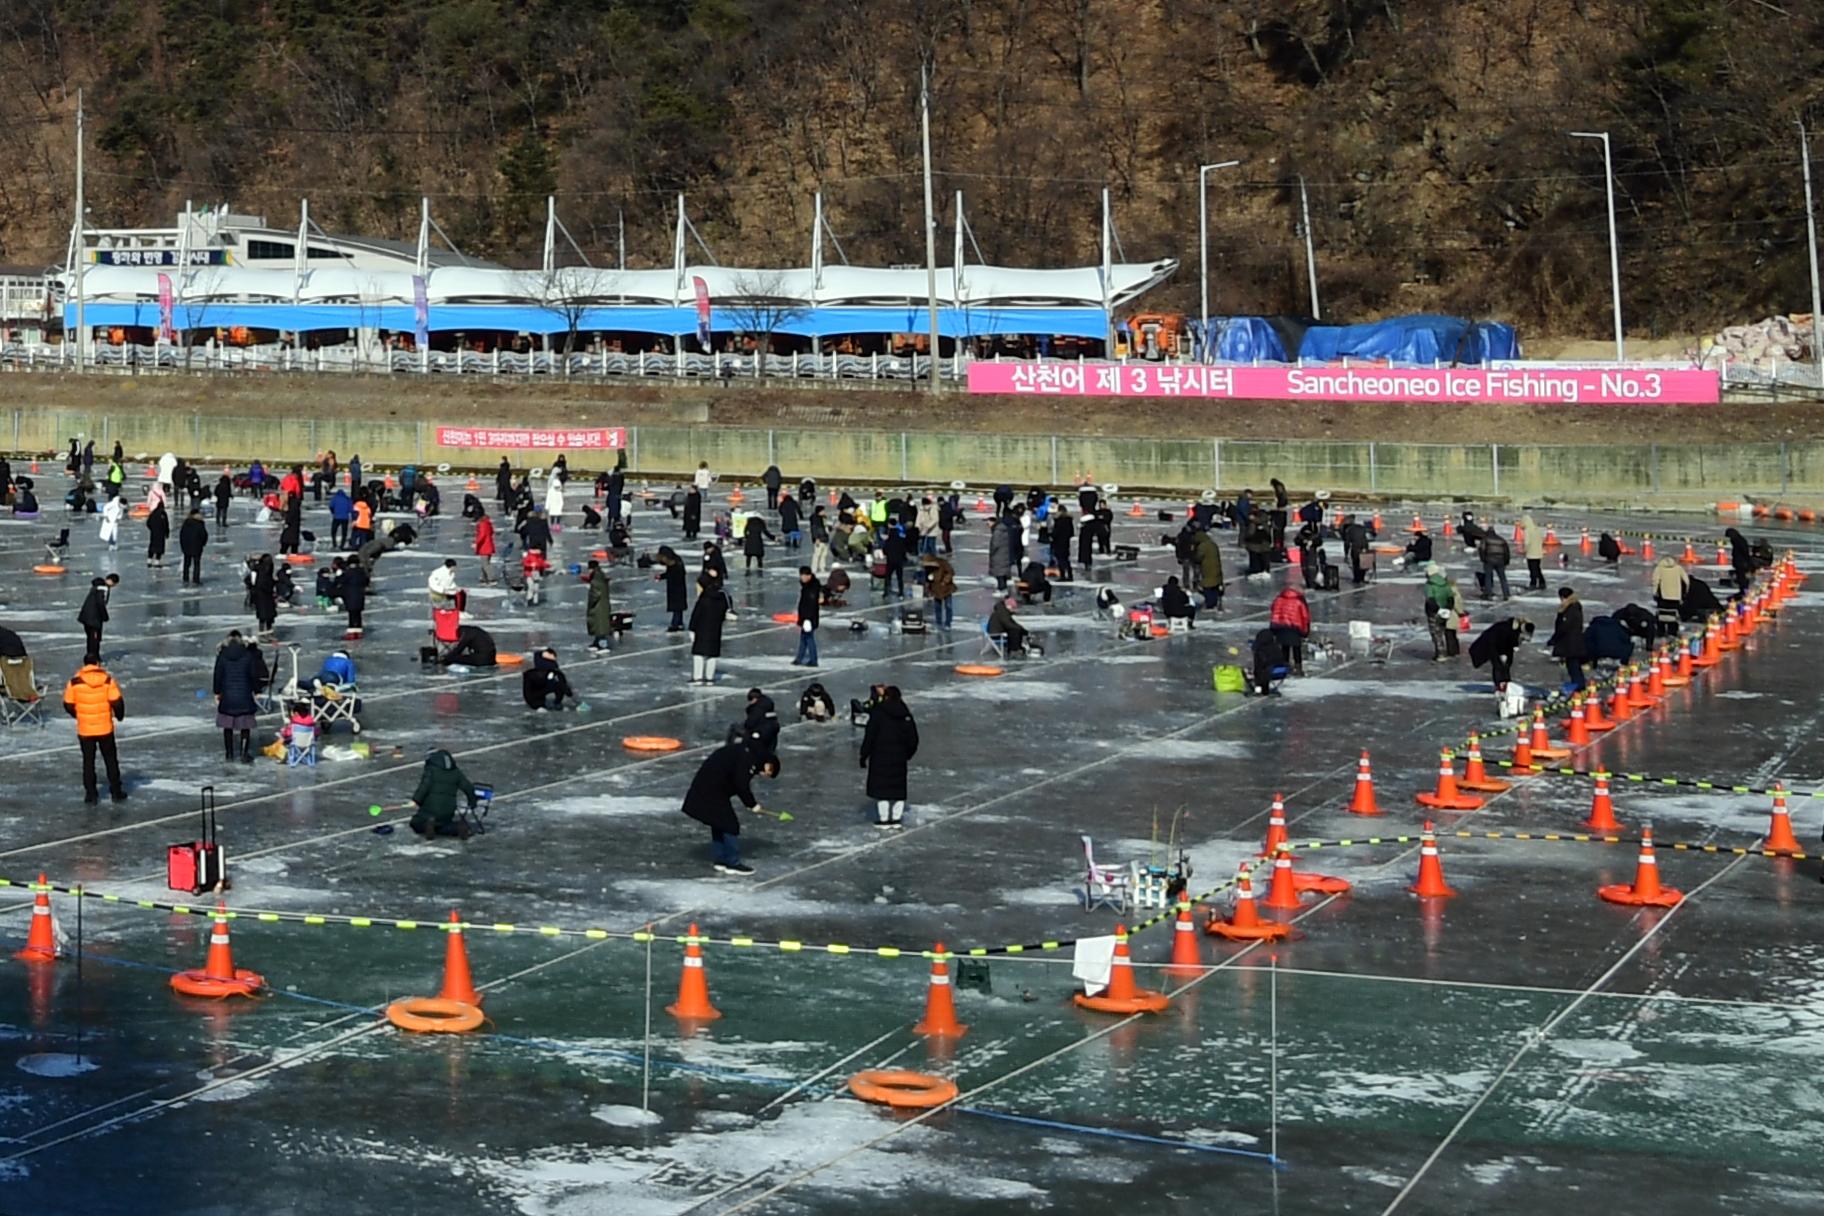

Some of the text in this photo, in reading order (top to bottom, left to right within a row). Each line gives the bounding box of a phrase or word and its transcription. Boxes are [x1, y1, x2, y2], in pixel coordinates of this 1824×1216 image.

[1011, 365, 1233, 395] 산천어 제 3 낚시터
[1287, 370, 1439, 396] Sancheoneo
[1445, 372, 1480, 396] Ice
[1487, 373, 1577, 401] Fishing
[1601, 373, 1662, 397] No.3
